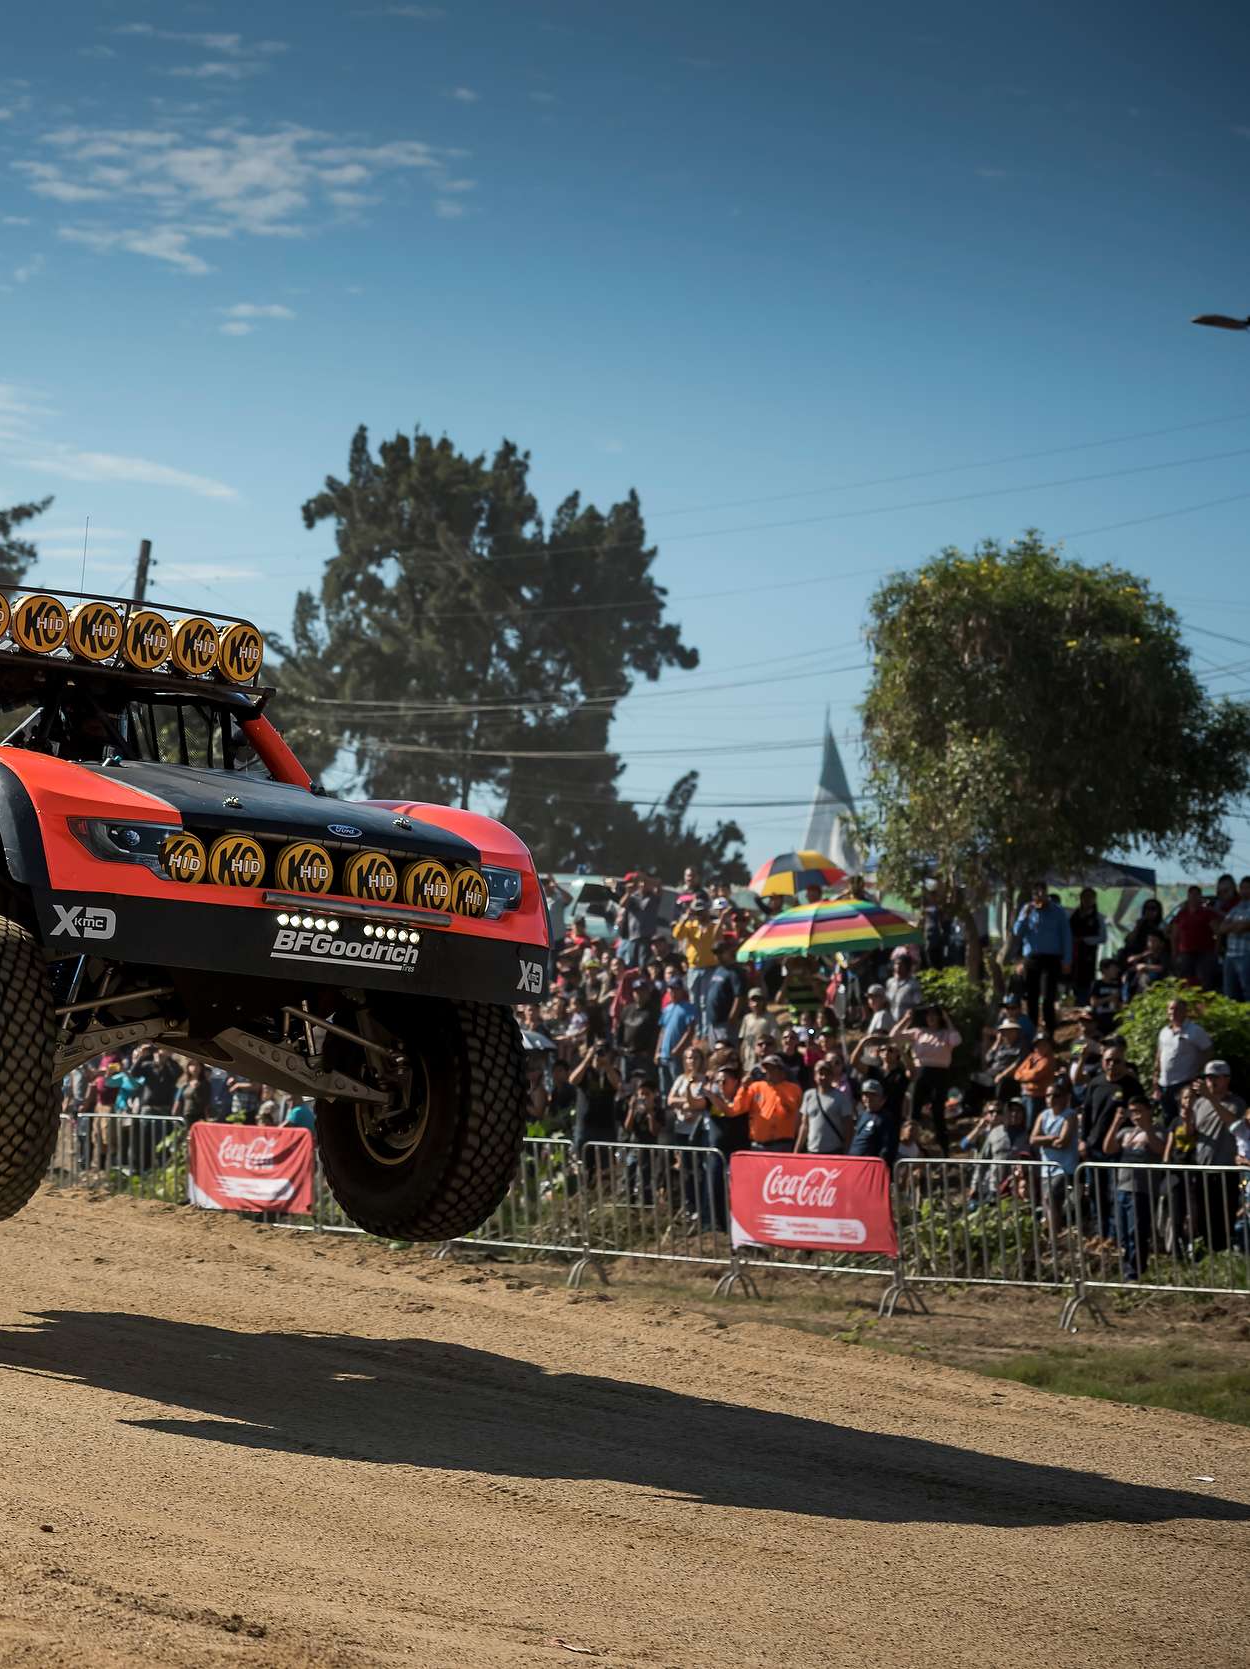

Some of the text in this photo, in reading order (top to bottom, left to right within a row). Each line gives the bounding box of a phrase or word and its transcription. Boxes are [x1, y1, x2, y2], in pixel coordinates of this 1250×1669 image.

[24, 602, 62, 646] KC
[36, 617, 64, 631] HID
[80, 608, 116, 653] KC
[91, 624, 118, 638] HID
[132, 619, 166, 662] KC
[143, 633, 168, 648] HID
[182, 624, 214, 668] KC
[193, 638, 216, 654] HID
[229, 632, 259, 675] KC
[239, 646, 260, 660] HID
[334, 824, 356, 835] Ford
[158, 840, 199, 883] KC
[168, 854, 201, 871] HID
[218, 842, 258, 887] KC
[231, 858, 261, 874] HID
[287, 849, 327, 894] KC
[300, 864, 329, 879] HID
[357, 858, 392, 901] KC
[368, 874, 395, 888] HID
[412, 867, 446, 911] KC
[423, 883, 448, 897] HID
[456, 875, 482, 918] KC
[465, 890, 483, 906] HID
[50, 904, 116, 940] XD
[273, 929, 419, 964] BFGoodrich
[401, 964, 415, 973] Tires
[516, 960, 543, 993] XD
[762, 1165, 843, 1207] Coca-Cola
